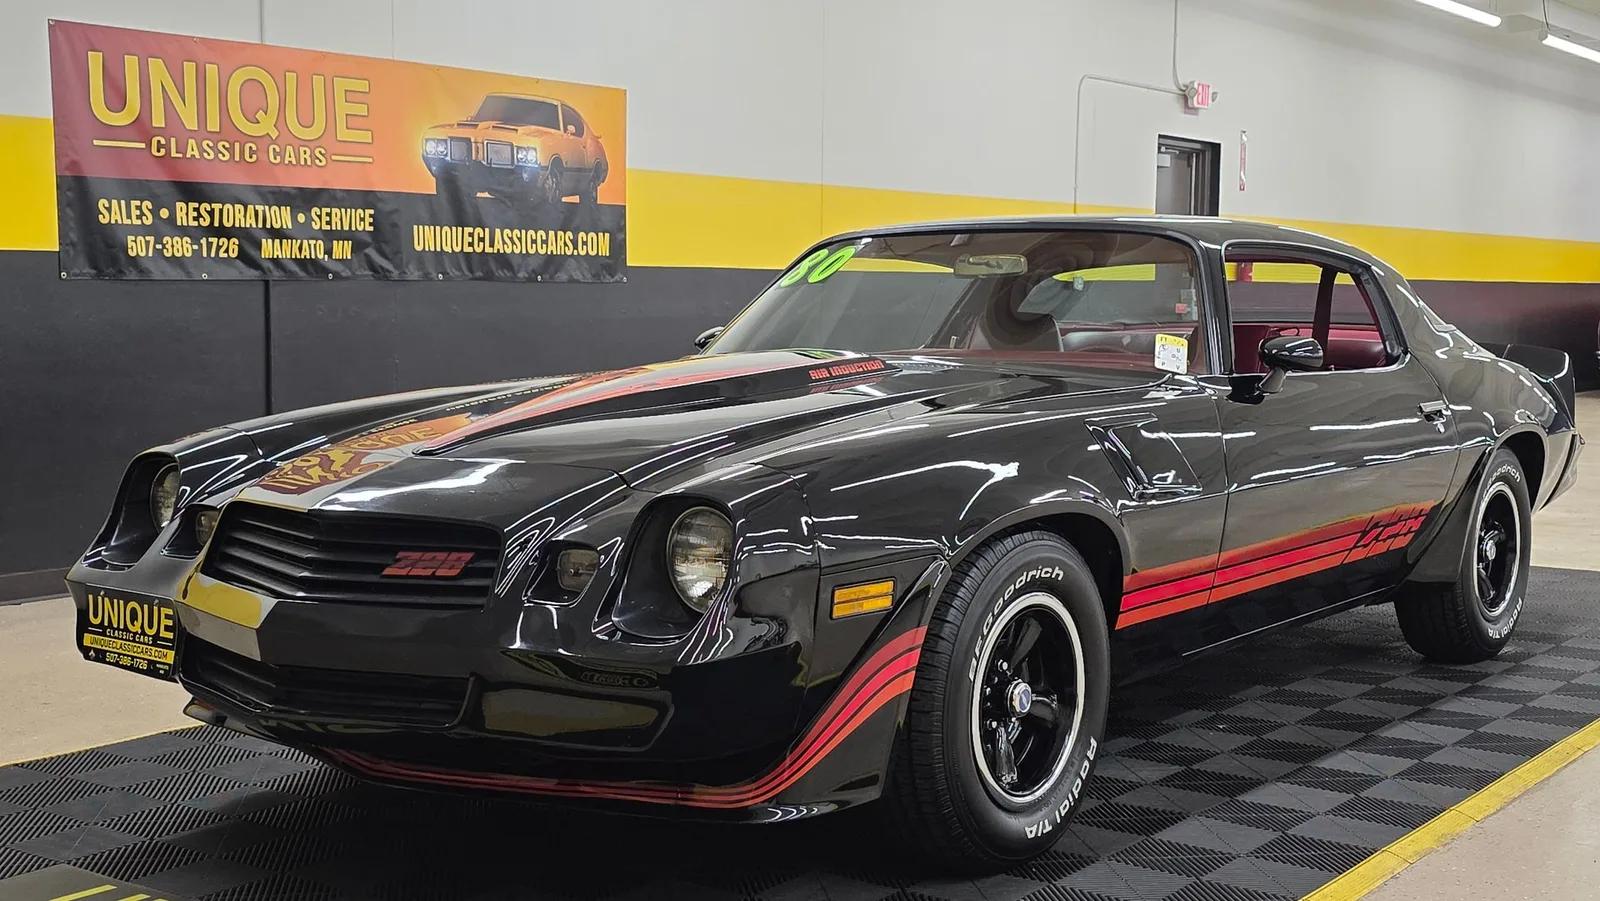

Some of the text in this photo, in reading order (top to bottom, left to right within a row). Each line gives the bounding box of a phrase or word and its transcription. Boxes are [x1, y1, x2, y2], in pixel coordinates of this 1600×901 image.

[87, 50, 374, 144] UNIQUE
[150, 136, 328, 167] CLASSIC CARS
[97, 198, 375, 232] SALES RESTORATION SERVICE
[127, 235, 239, 259] 507-386-1726
[332, 240, 353, 260] MN
[412, 224, 611, 257] UNIQUECLASSICCARS.COM
[780, 245, 856, 288] 80
[809, 359, 885, 380] AIR INDUCTION
[381, 551, 476, 577] Z28
[88, 594, 174, 640] UNIQUE
[1501, 597, 1523, 638] Radial
[89, 635, 169, 661] UNIQUECLASSICCARS.COM
[106, 628, 153, 645] CLASSIC CARS
[105, 652, 148, 670] 507-386-1726
[1025, 736, 1098, 839] Radial T/A
